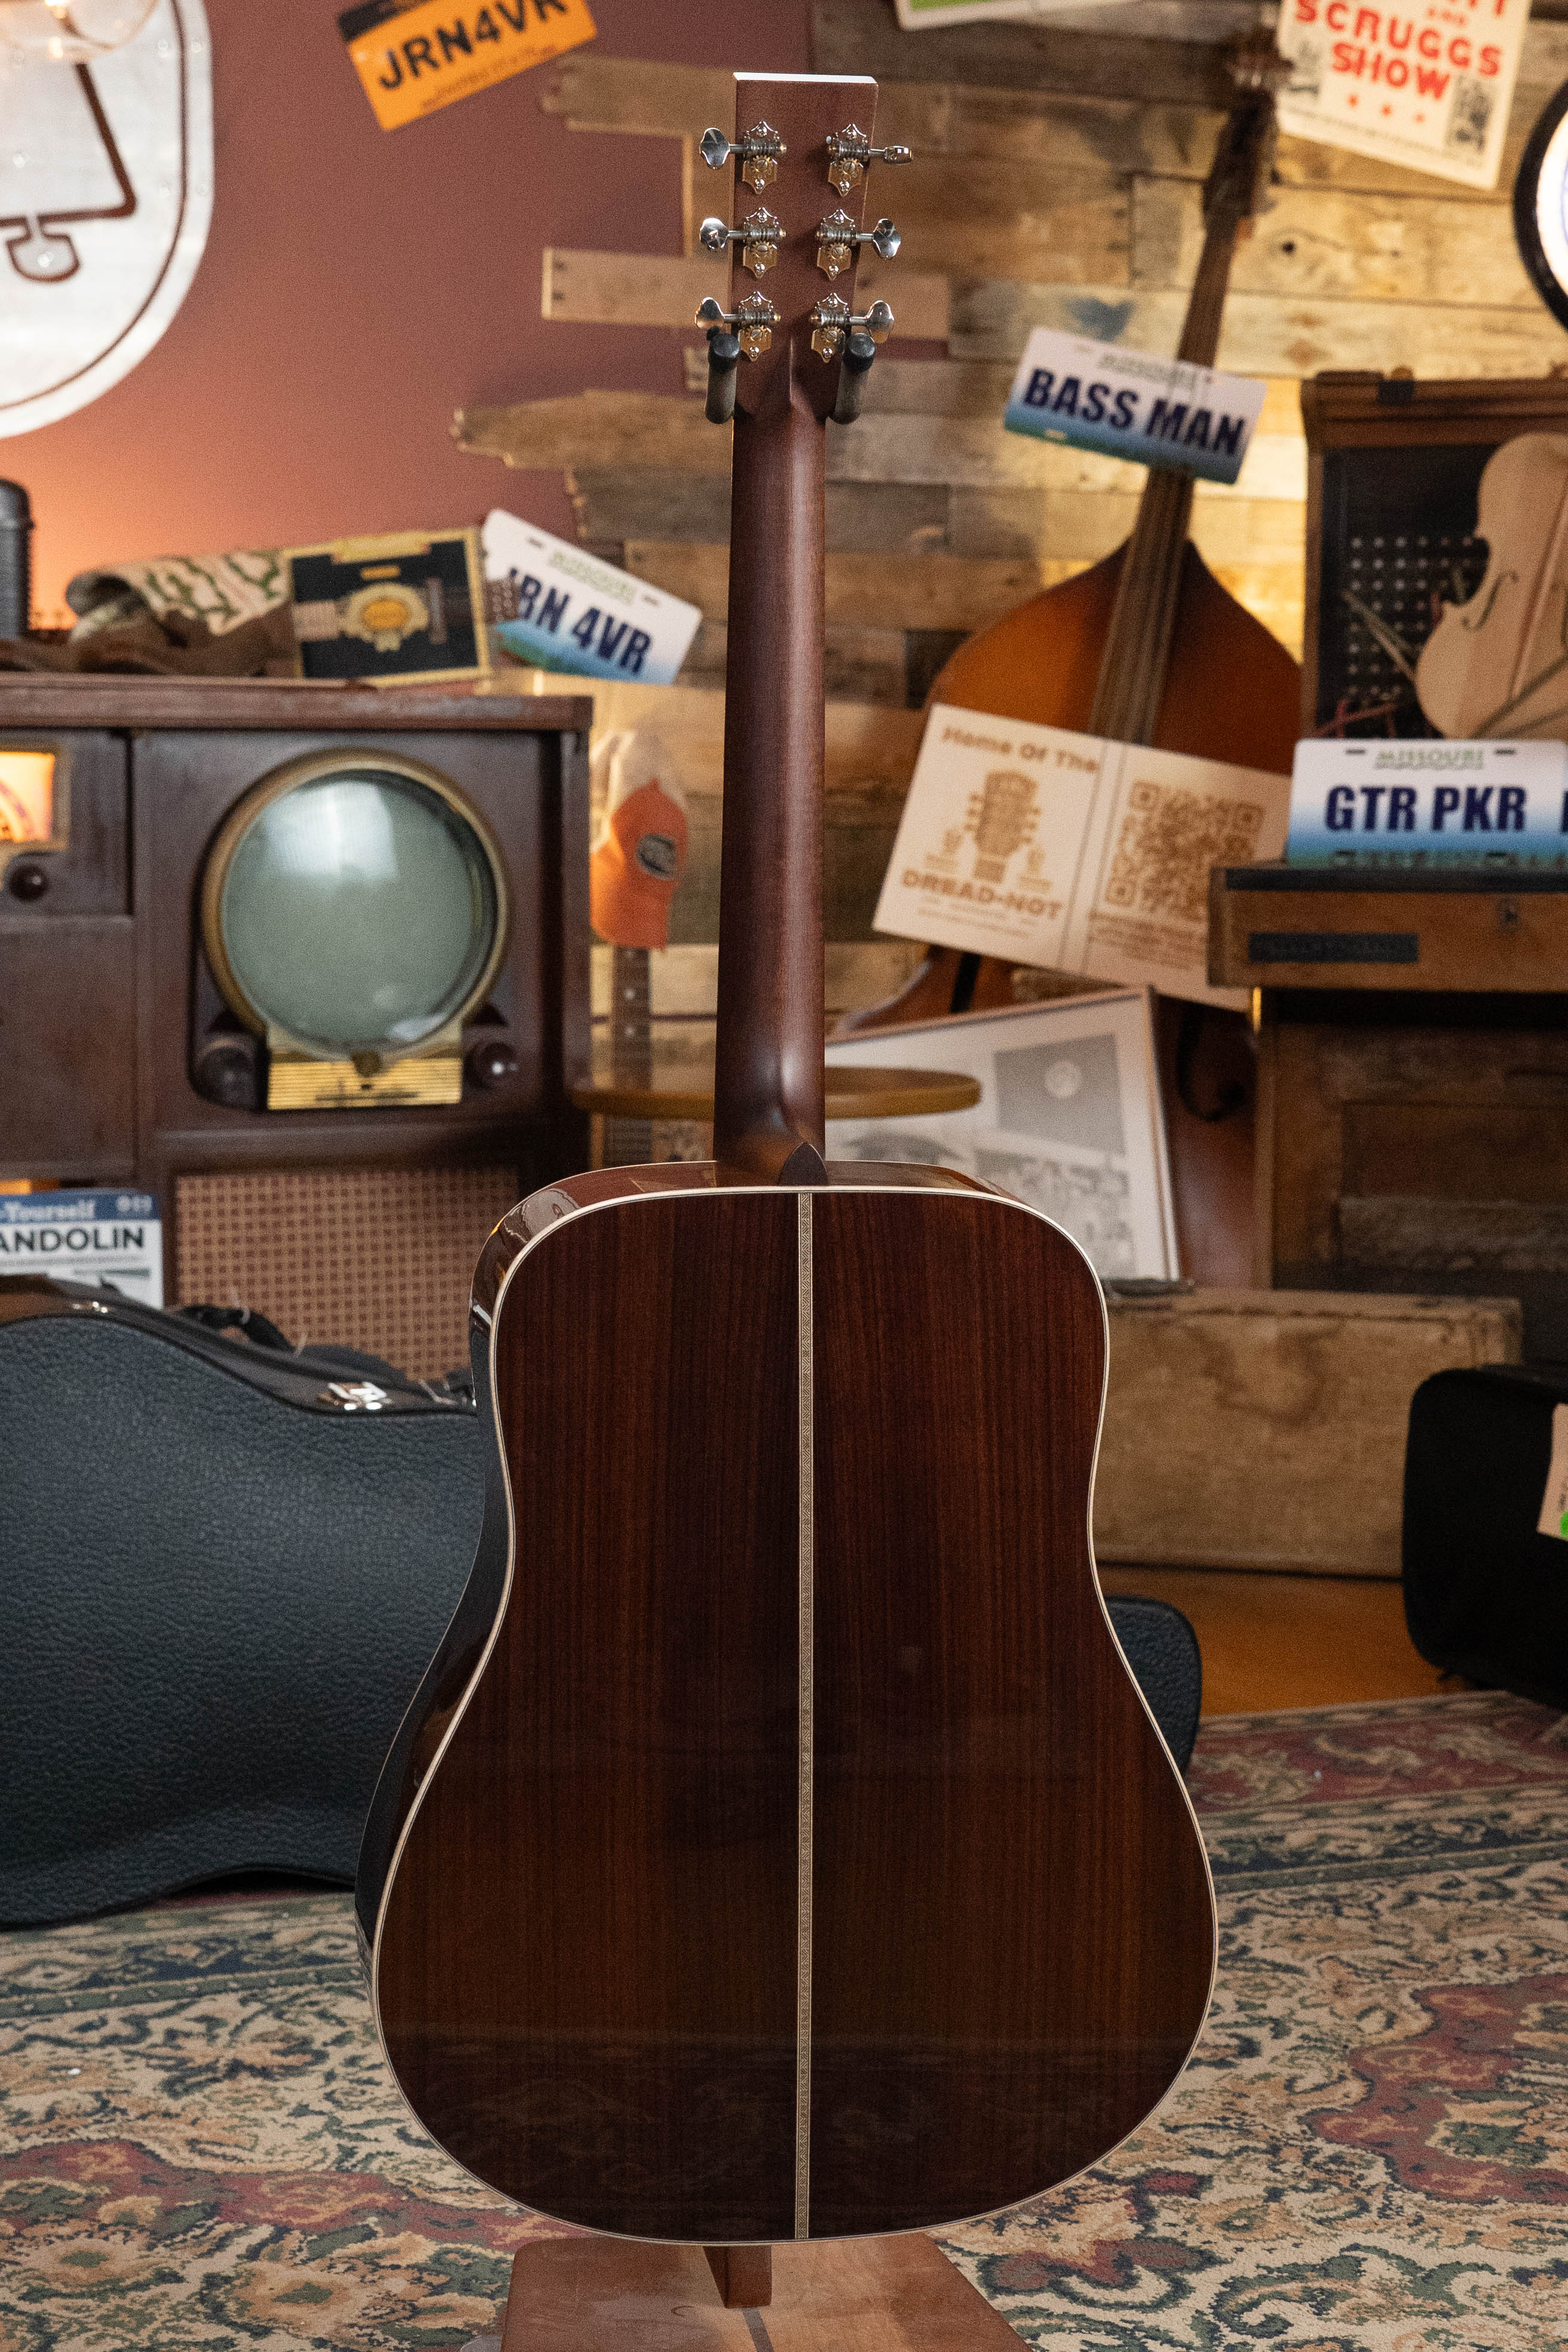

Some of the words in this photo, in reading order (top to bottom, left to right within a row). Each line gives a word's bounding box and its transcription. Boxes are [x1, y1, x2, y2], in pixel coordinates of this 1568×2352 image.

[1295, 0, 1502, 77] SCRUGGS
[1331, 41, 1451, 100] SHOW
[1022, 368, 1140, 430] BASS
[1144, 398, 1245, 456] MAN
[509, 568, 570, 635] RN
[571, 607, 653, 676] 4VR
[941, 725, 1013, 755] Home
[1019, 743, 1049, 762] Of
[1056, 748, 1100, 773] The
[1324, 785, 1417, 832] GTR
[1431, 785, 1527, 832] PKR
[901, 868, 1064, 920] DREAD-NOT
